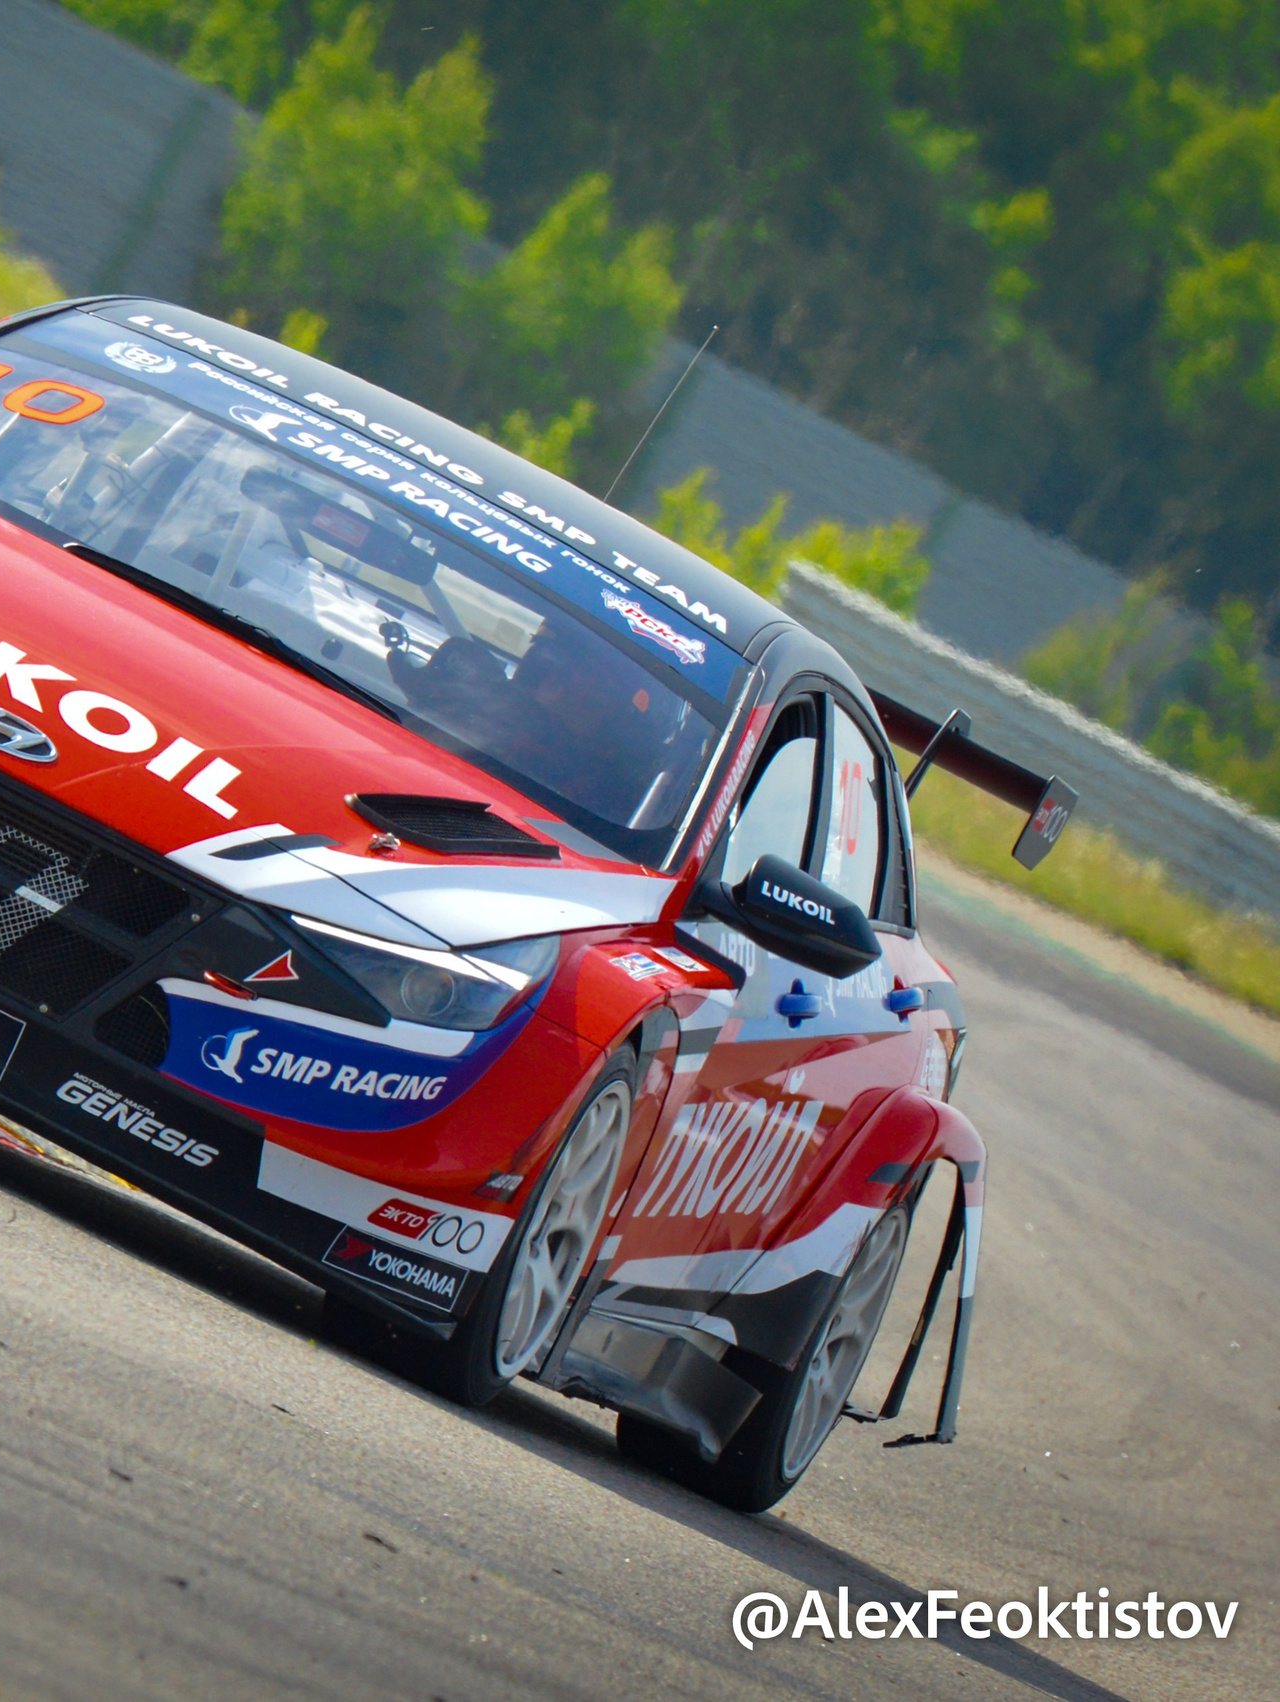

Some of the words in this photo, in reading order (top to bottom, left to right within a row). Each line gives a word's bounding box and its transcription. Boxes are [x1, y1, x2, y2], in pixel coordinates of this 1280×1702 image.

[128, 315, 289, 388] LUKOIL
[304, 392, 484, 485] RACING
[497, 491, 596, 545] SMP
[612, 551, 727, 634] TEAM
[287, 431, 391, 481] SMP
[388, 481, 554, 573] RACING
[761, 880, 836, 926] LUKOIL
[250, 1048, 332, 1084] SMP
[330, 1065, 448, 1101] RACING
[56, 1079, 220, 1167] GENESIS
[123, 1097, 156, 1118] МАСЛА
[368, 1249, 456, 1298] YOKOHAMA
